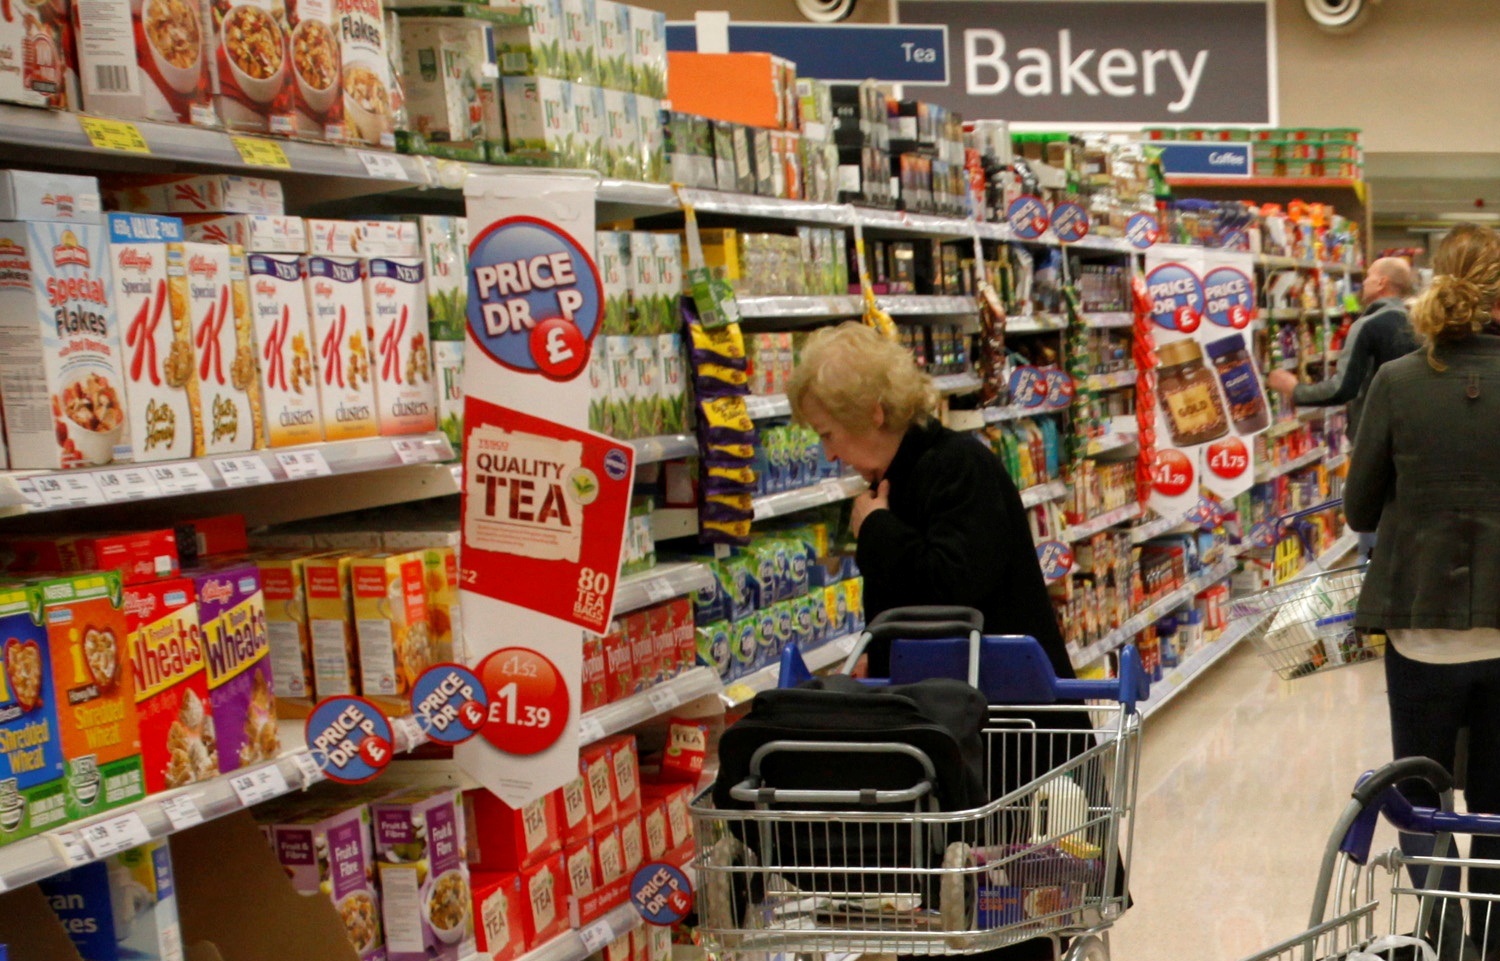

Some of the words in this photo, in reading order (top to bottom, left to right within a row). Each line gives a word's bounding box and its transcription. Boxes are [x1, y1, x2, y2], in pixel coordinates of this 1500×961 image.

[342, 16, 381, 45] Flakes
[901, 43, 936, 63] Tea
[964, 28, 1208, 112] Bakery
[1208, 153, 1244, 166] Coffee
[130, 217, 163, 240] VALUE
[274, 262, 298, 280] NEW
[332, 264, 356, 282] NEW
[396, 264, 420, 282] NEW
[475, 252, 577, 300] PRICE
[46, 273, 109, 308] special
[121, 278, 153, 295] Special
[1150, 277, 1195, 298] PRICE
[1204, 278, 1247, 299] PRICE
[55, 304, 107, 339] Flakes
[546, 327, 574, 365] £
[1178, 401, 1208, 417] GOLD
[476, 453, 565, 479] QUALITY
[1211, 449, 1246, 468] £1.75
[475, 475, 572, 527] TEA
[577, 567, 609, 595] 80
[573, 602, 603, 621] BAGS
[576, 589, 605, 610] TEA
[202, 603, 268, 681] Wheats
[502, 656, 537, 677] £1.52
[418, 671, 465, 717] PRICE
[487, 682, 551, 728] £1.39
[73, 701, 126, 730] Shredded
[466, 705, 482, 725] £
[85, 723, 121, 749] Wheat
[314, 704, 365, 754] PRICE
[8, 747, 46, 775] Wheat
[366, 738, 387, 762] £
[636, 868, 671, 904] PRICE
